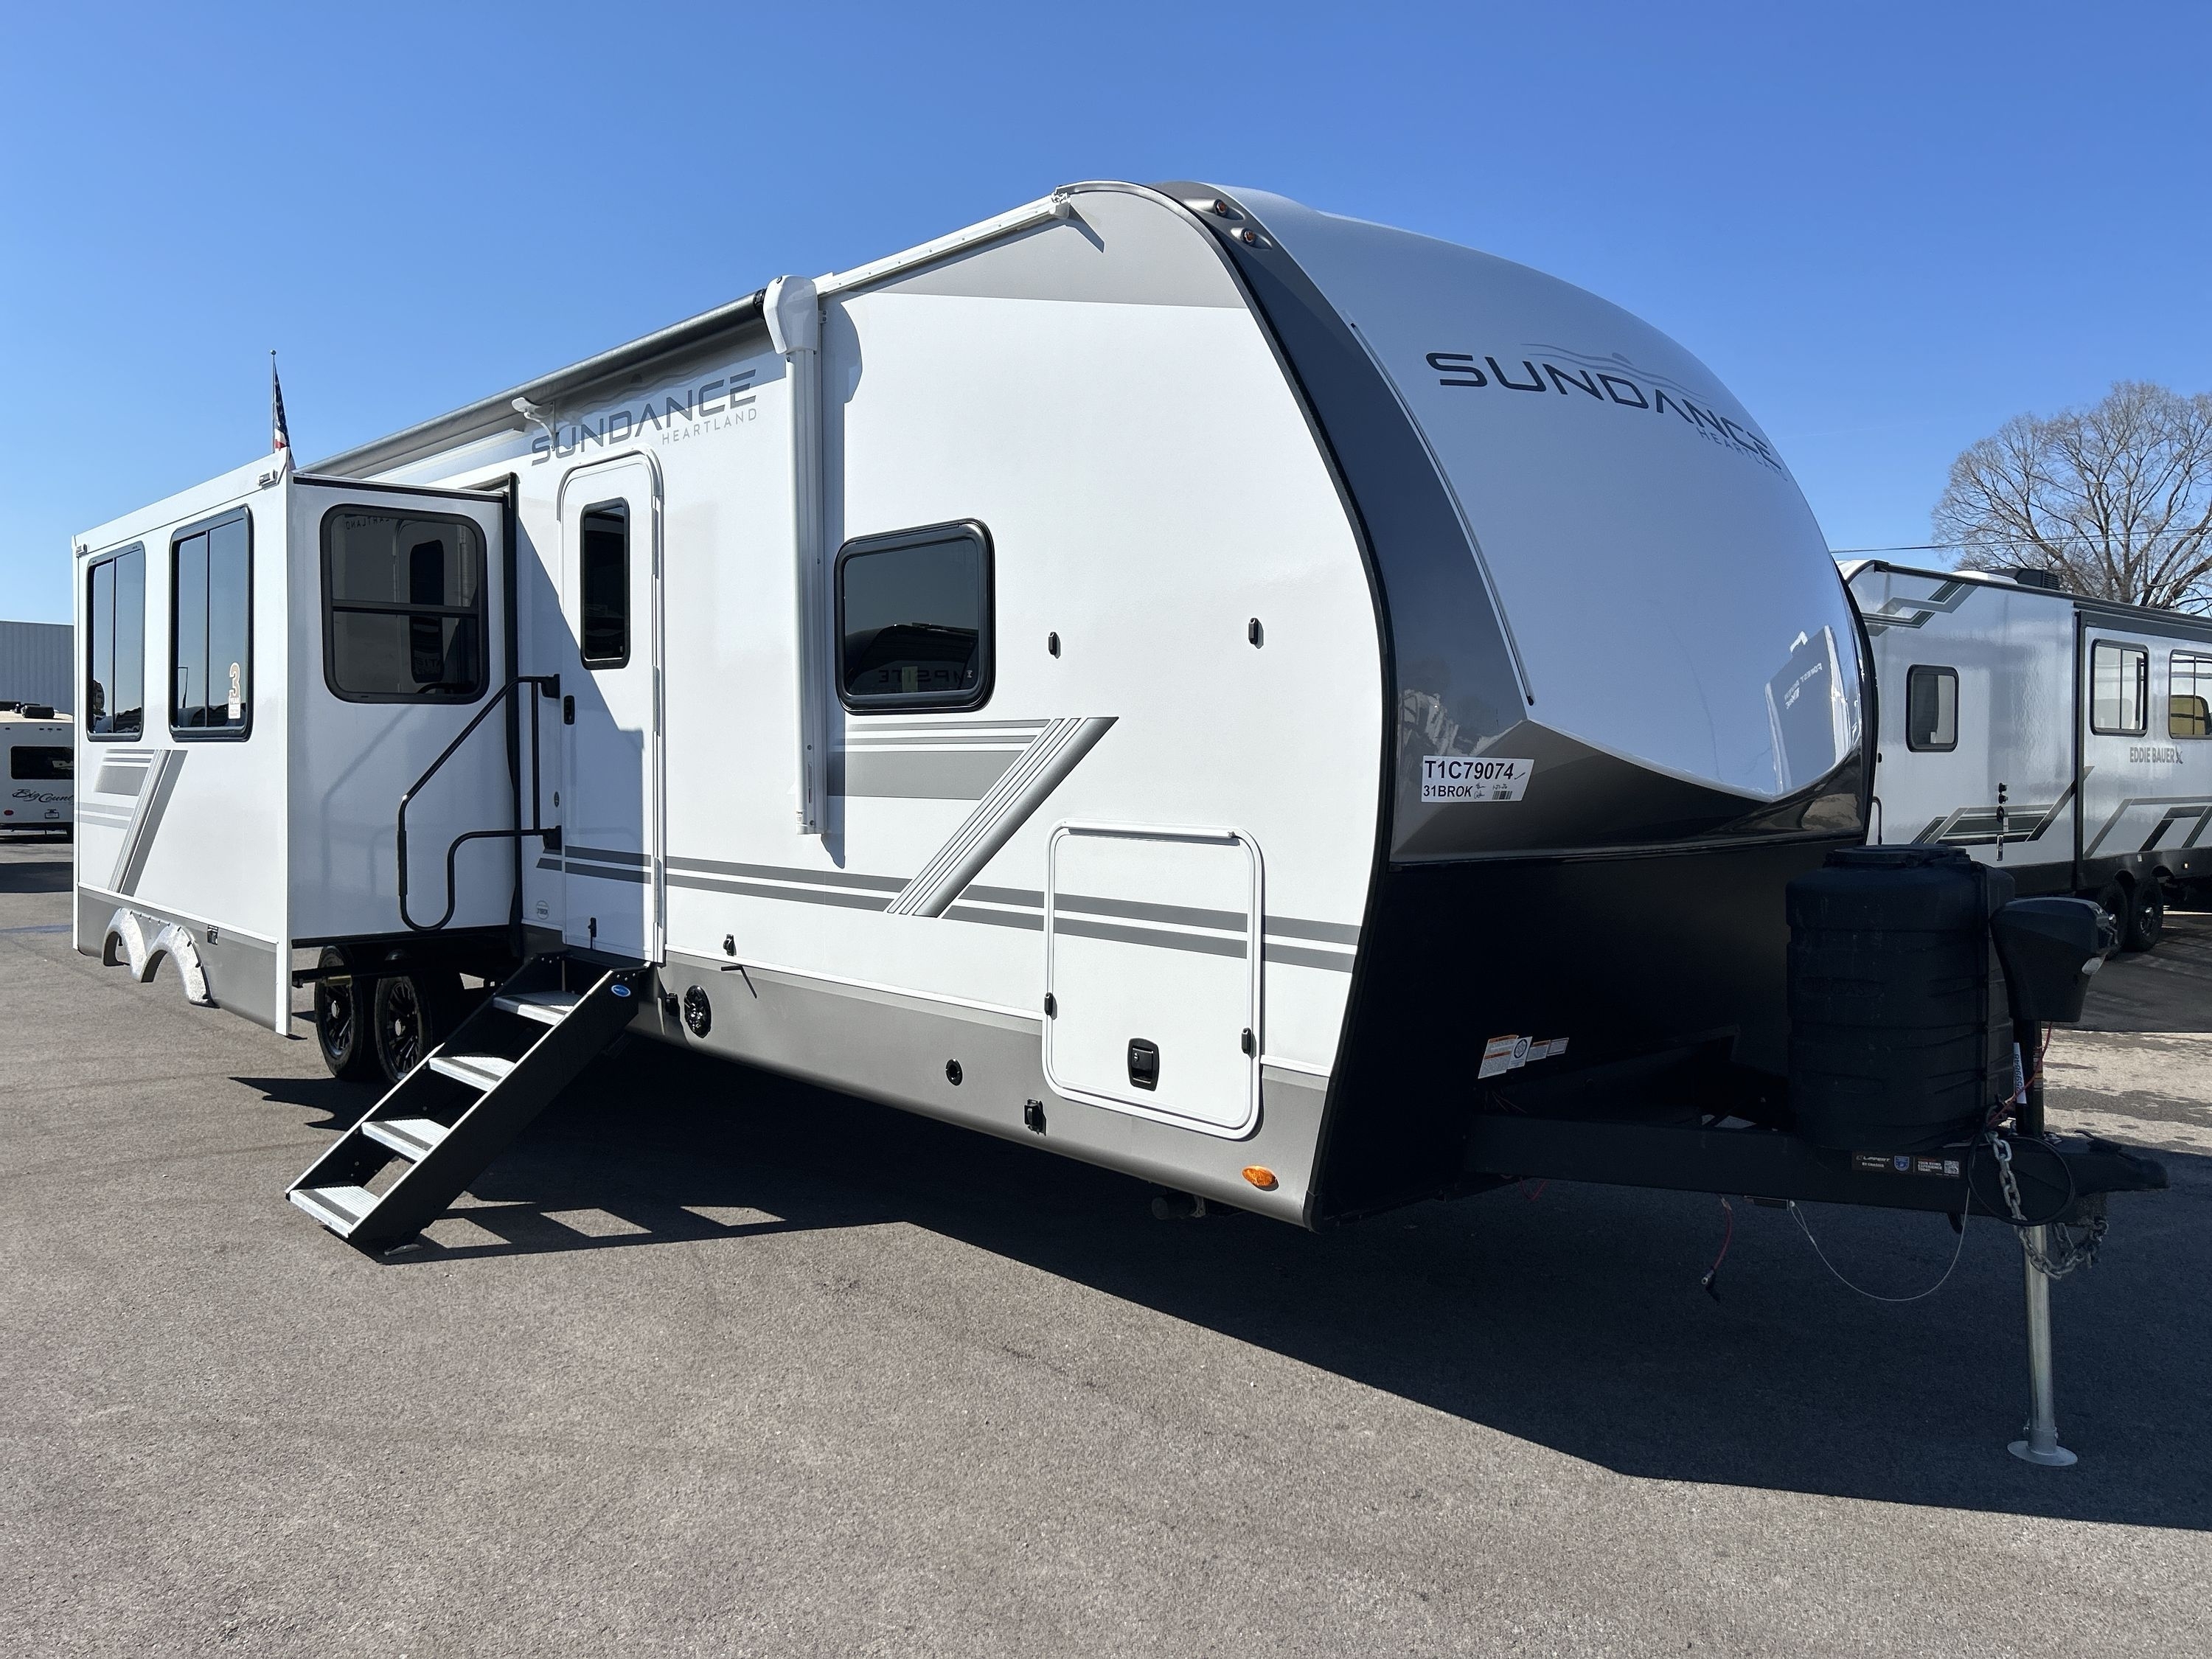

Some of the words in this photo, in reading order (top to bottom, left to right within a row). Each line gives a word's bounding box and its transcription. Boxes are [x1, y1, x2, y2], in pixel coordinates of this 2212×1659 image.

[531, 369, 757, 466] SUNDANCE
[1425, 352, 1781, 470] SUNDANCE
[662, 408, 757, 445] HEARTLAND
[2129, 747, 2150, 763] EDDIE
[2152, 747, 2174, 763] BAUER
[1425, 760, 1514, 780] T1C79074
[12, 788, 40, 802] Big
[38, 793, 74, 803] Count
[1423, 785, 1473, 797] 31BROK
